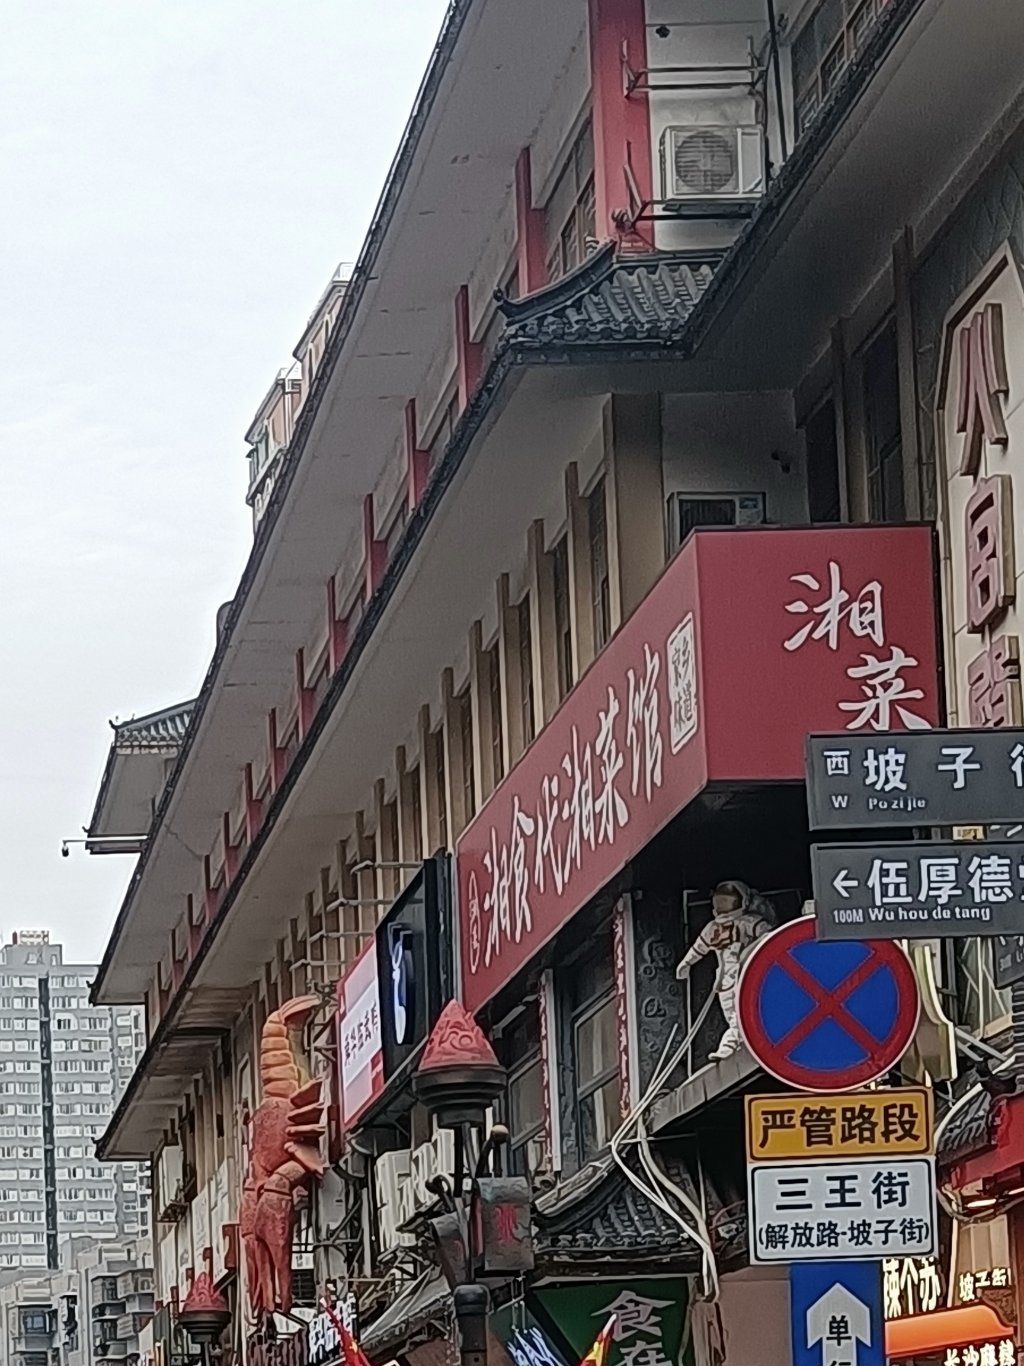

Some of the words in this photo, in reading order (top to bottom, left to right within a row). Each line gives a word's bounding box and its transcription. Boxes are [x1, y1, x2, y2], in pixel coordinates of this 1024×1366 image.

[783, 561, 934, 730] 湘菜
[824, 750, 850, 775] 西
[832, 796, 848, 808] W
[867, 855, 1024, 906] 伍厚德
[833, 908, 863, 923] 100M
[869, 907, 894, 921] Wu
[899, 906, 928, 920] hou
[932, 906, 951, 919] de
[955, 906, 991, 920] tang
[759, 1103, 921, 1149] 严管路段
[776, 1171, 910, 1210] 三王街
[759, 1217, 930, 1250] (解放路-坡子街)
